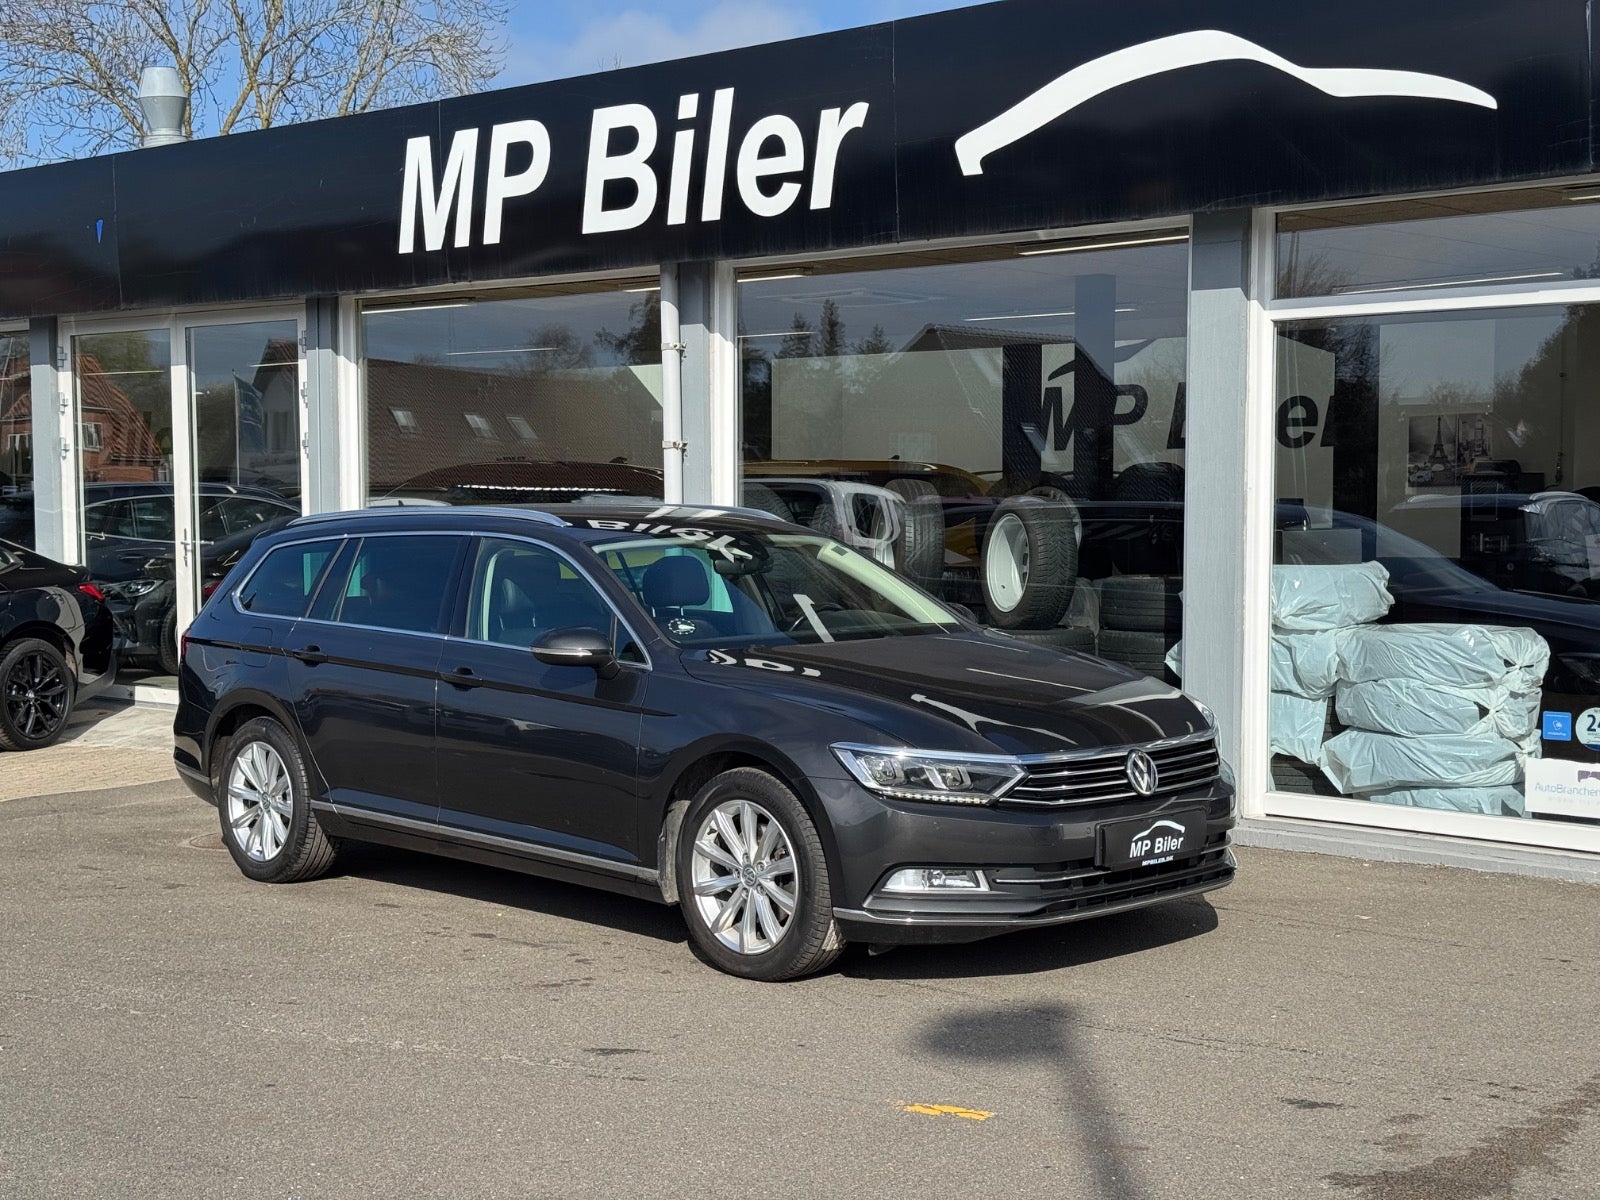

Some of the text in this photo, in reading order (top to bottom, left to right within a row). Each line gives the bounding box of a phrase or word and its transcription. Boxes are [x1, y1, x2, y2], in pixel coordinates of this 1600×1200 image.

[399, 87, 869, 254] MP Biler
[1129, 834, 1185, 858] MP Biler
